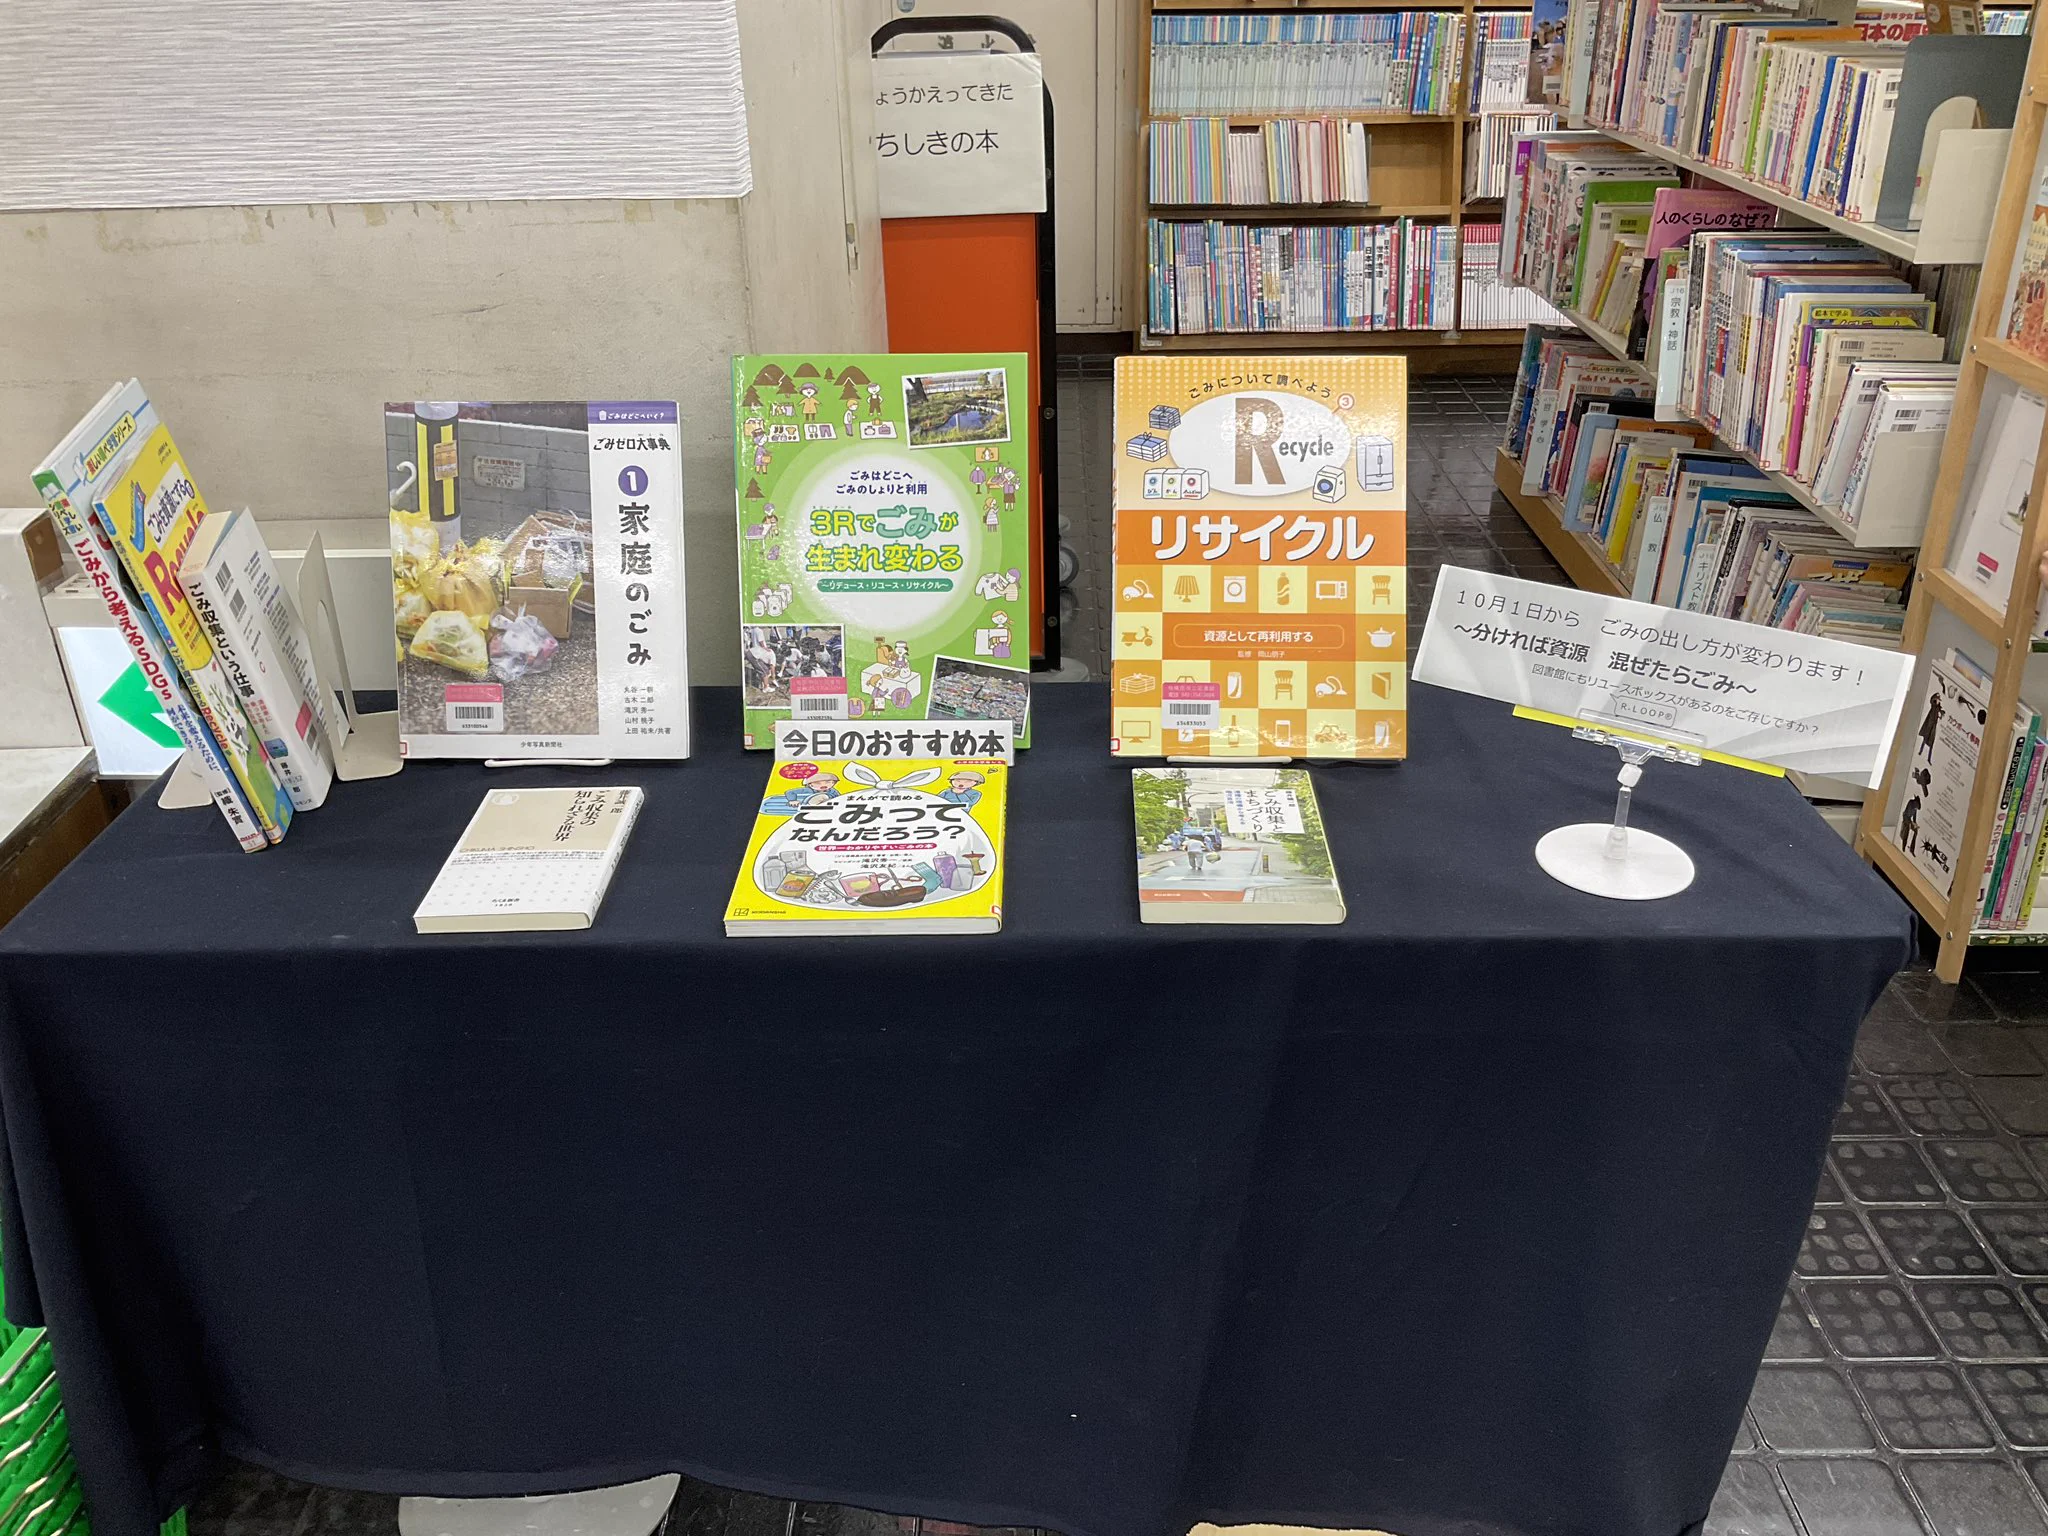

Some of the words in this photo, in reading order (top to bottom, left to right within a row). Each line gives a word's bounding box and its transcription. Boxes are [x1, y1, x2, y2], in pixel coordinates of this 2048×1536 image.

[875, 128, 999, 158] ちしきの本
[1656, 211, 1771, 228] 人のくらしのなぜ？
[1666, 297, 1682, 351] 宗教・神話
[1188, 373, 1332, 399] ごみについて調べよう
[607, 412, 665, 420] ごみはどこへいく？
[593, 436, 671, 451] ごみゼロ大事典
[1234, 397, 1334, 485] Recycle
[835, 483, 928, 495] ごみのしょりと利用
[849, 470, 913, 482] ごみはどこへ
[809, 504, 960, 540] 3Rでごみが
[1151, 514, 1376, 562] リサイクル
[1647, 513, 1663, 553] 仏教
[805, 543, 964, 572] 生まれ変わる
[617, 502, 653, 667] 家庭のごみ
[1687, 562, 1709, 611] キリスト教
[74, 537, 173, 701] ごみから考えるSDGs
[1203, 630, 1314, 643] 資源として再利用する
[189, 582, 256, 698] ごみ収集という仕事
[1453, 620, 1591, 664] ～分ければ資源
[1607, 650, 1758, 696] 混ぜたらごみ～
[1599, 617, 1865, 688] ごみの出し方が変わります！
[1531, 663, 1821, 735] 図書館にもリユースボックスがあるのをご存じですか？
[782, 728, 1006, 757] 今日のおすすめ本
[552, 790, 593, 842] 知られざる世界
[580, 790, 611, 826] ごみ収集の
[793, 802, 968, 825] ごみって
[1244, 789, 1263, 832] まちづくり
[1264, 790, 1286, 832] ごみ収集と
[788, 825, 966, 842] なんだろう？
[818, 843, 934, 851] 世界一わかりやすいごみの本
